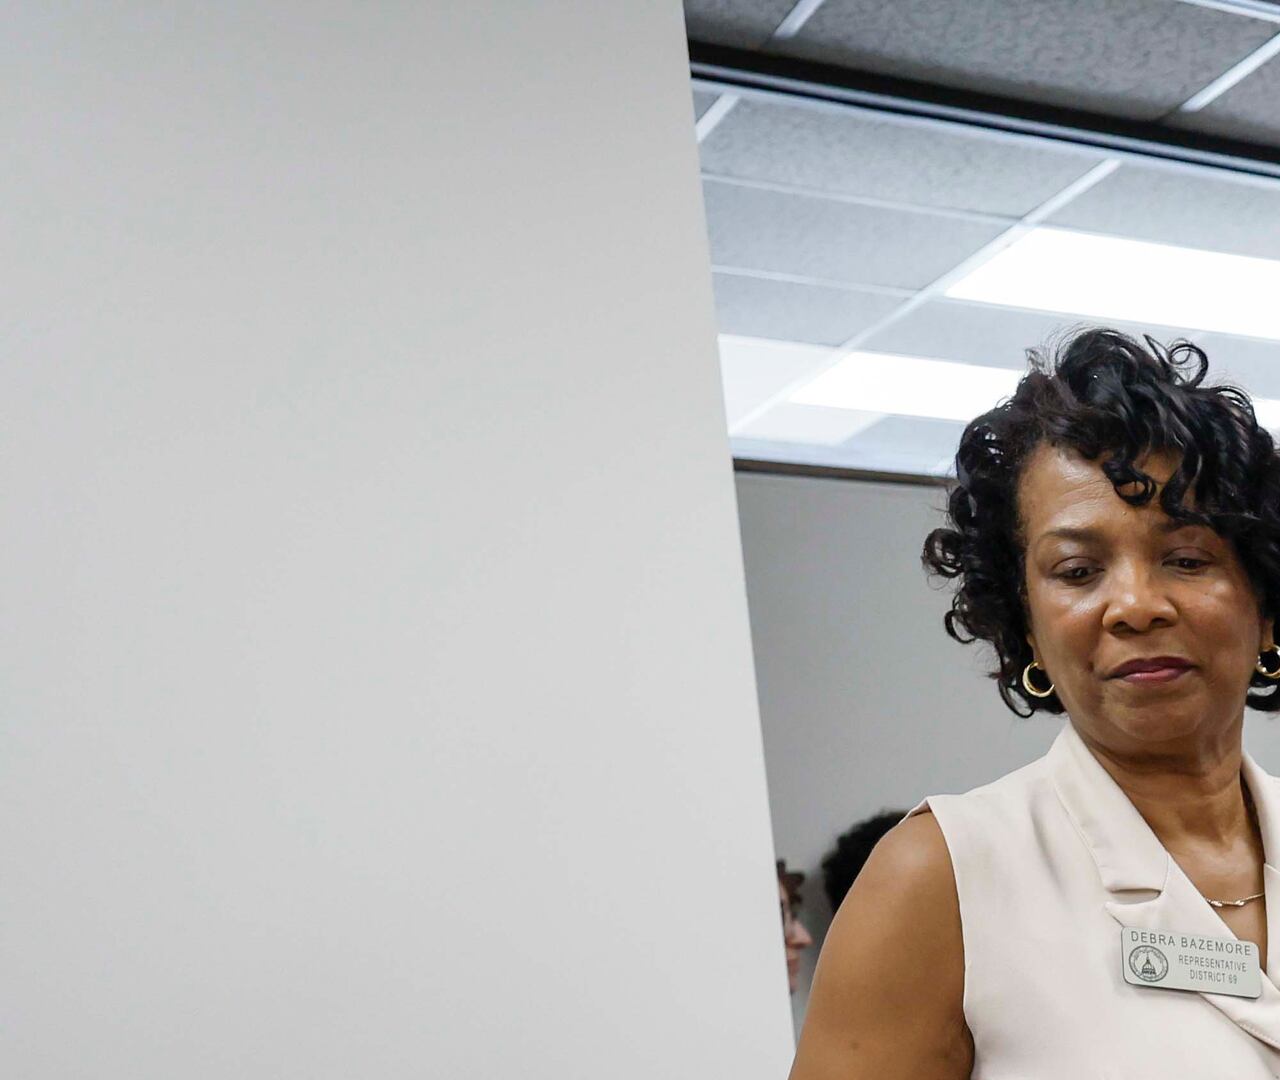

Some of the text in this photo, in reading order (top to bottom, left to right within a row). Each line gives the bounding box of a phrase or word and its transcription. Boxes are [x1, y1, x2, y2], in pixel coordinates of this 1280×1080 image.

[1131, 930, 1251, 956] DEBRA BAZEMORE
[1178, 954, 1247, 973] REPRESENTATIVE
[1189, 969, 1226, 985] DISTRICT
